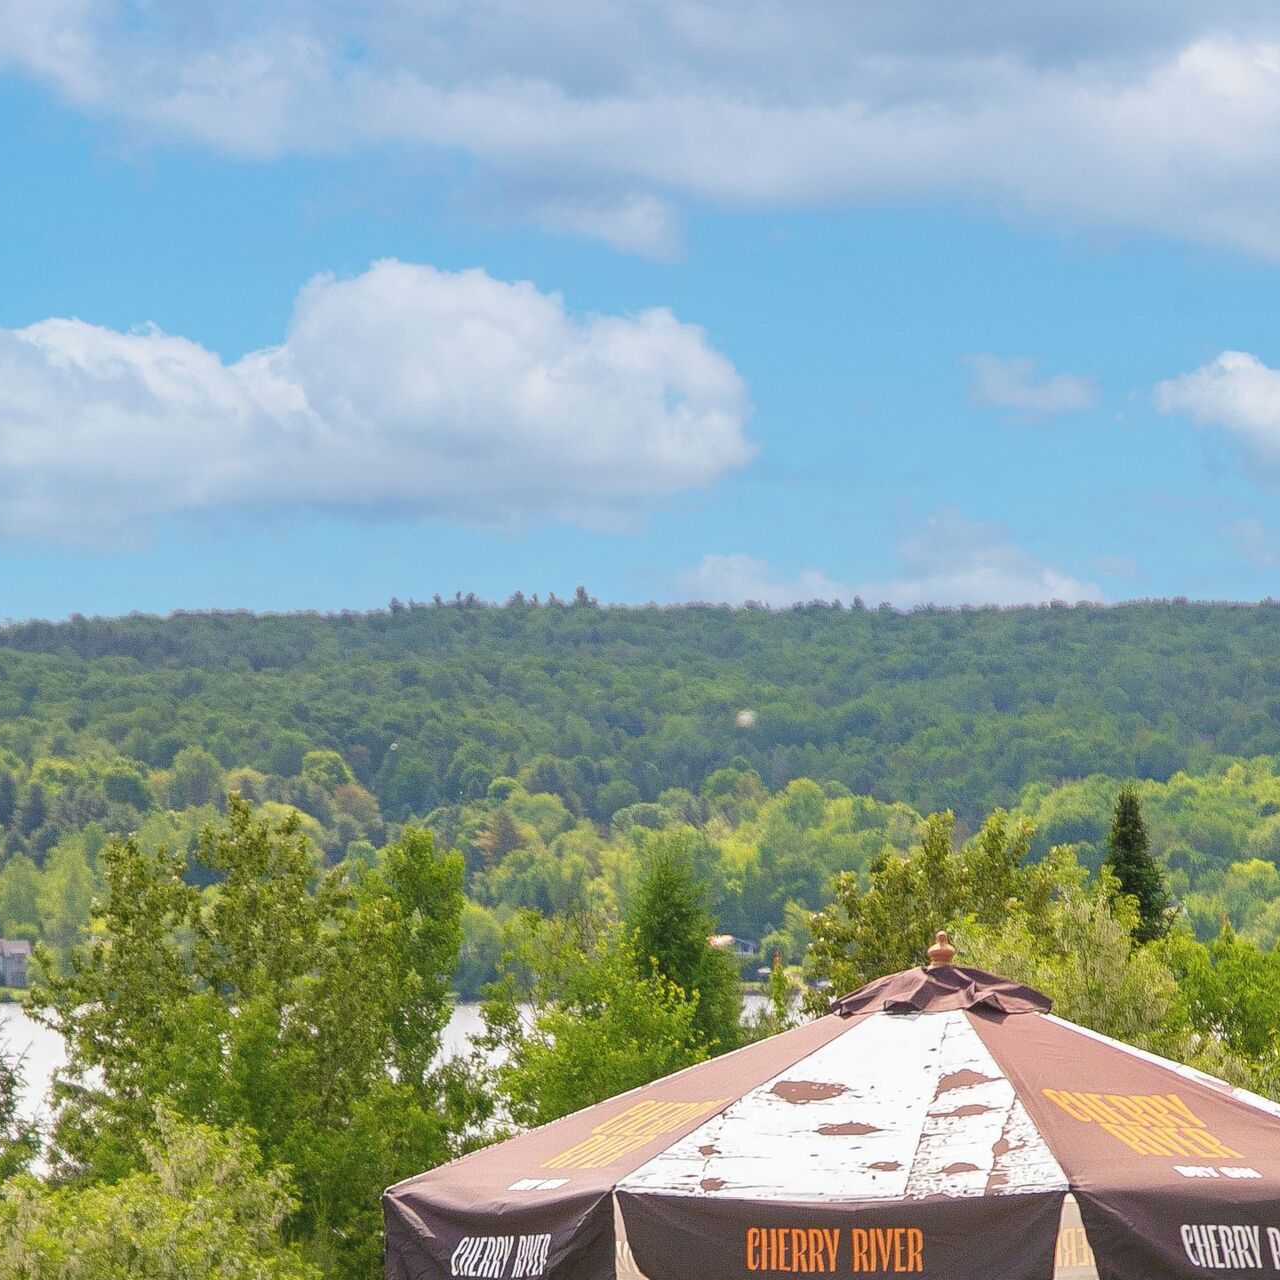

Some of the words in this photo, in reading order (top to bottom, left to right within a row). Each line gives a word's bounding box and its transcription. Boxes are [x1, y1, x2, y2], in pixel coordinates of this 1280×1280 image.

[1040, 1088, 1207, 1128] CHERRY
[1100, 1122, 1245, 1159] RIVER
[451, 1236, 515, 1279] CHERRY
[511, 1233, 552, 1278] RIVER
[746, 1227, 841, 1273] CHERRY
[851, 1227, 924, 1273] RIVER
[1180, 1224, 1263, 1269] CHERRY
